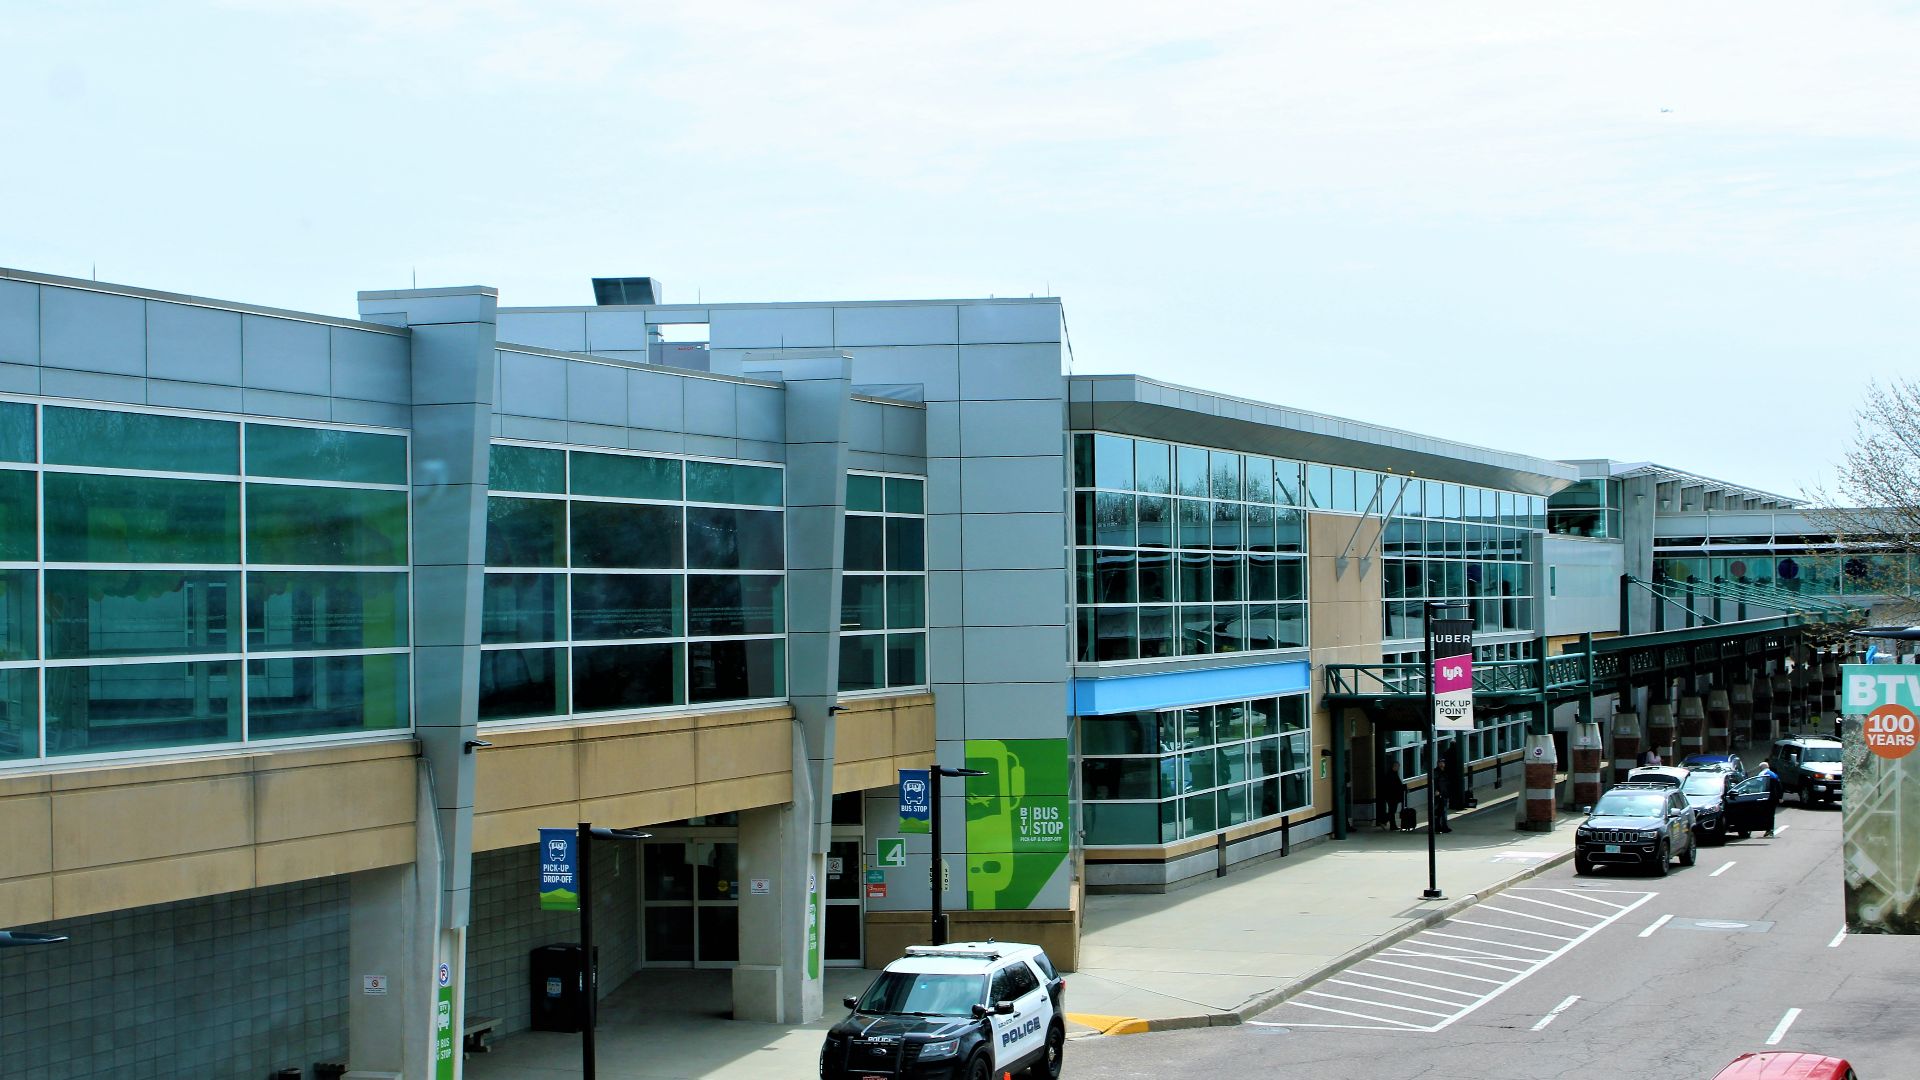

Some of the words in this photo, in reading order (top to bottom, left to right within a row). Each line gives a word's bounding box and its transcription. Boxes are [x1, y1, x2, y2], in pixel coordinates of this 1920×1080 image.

[1435, 634, 1471, 643] UBER
[1442, 665, 1463, 681] lyft
[1868, 714, 1915, 733] 100
[1867, 734, 1915, 746] YEARS
[1033, 806, 1059, 820] BUS
[1033, 821, 1064, 835] STOP
[885, 843, 905, 867] 4
[543, 863, 570, 872] PICK-UP
[543, 875, 573, 884] DROP-OFF
[1002, 1016, 1041, 1048] POLICE
[440, 1038, 450, 1050] BUS
[440, 1048, 452, 1060] STOP
